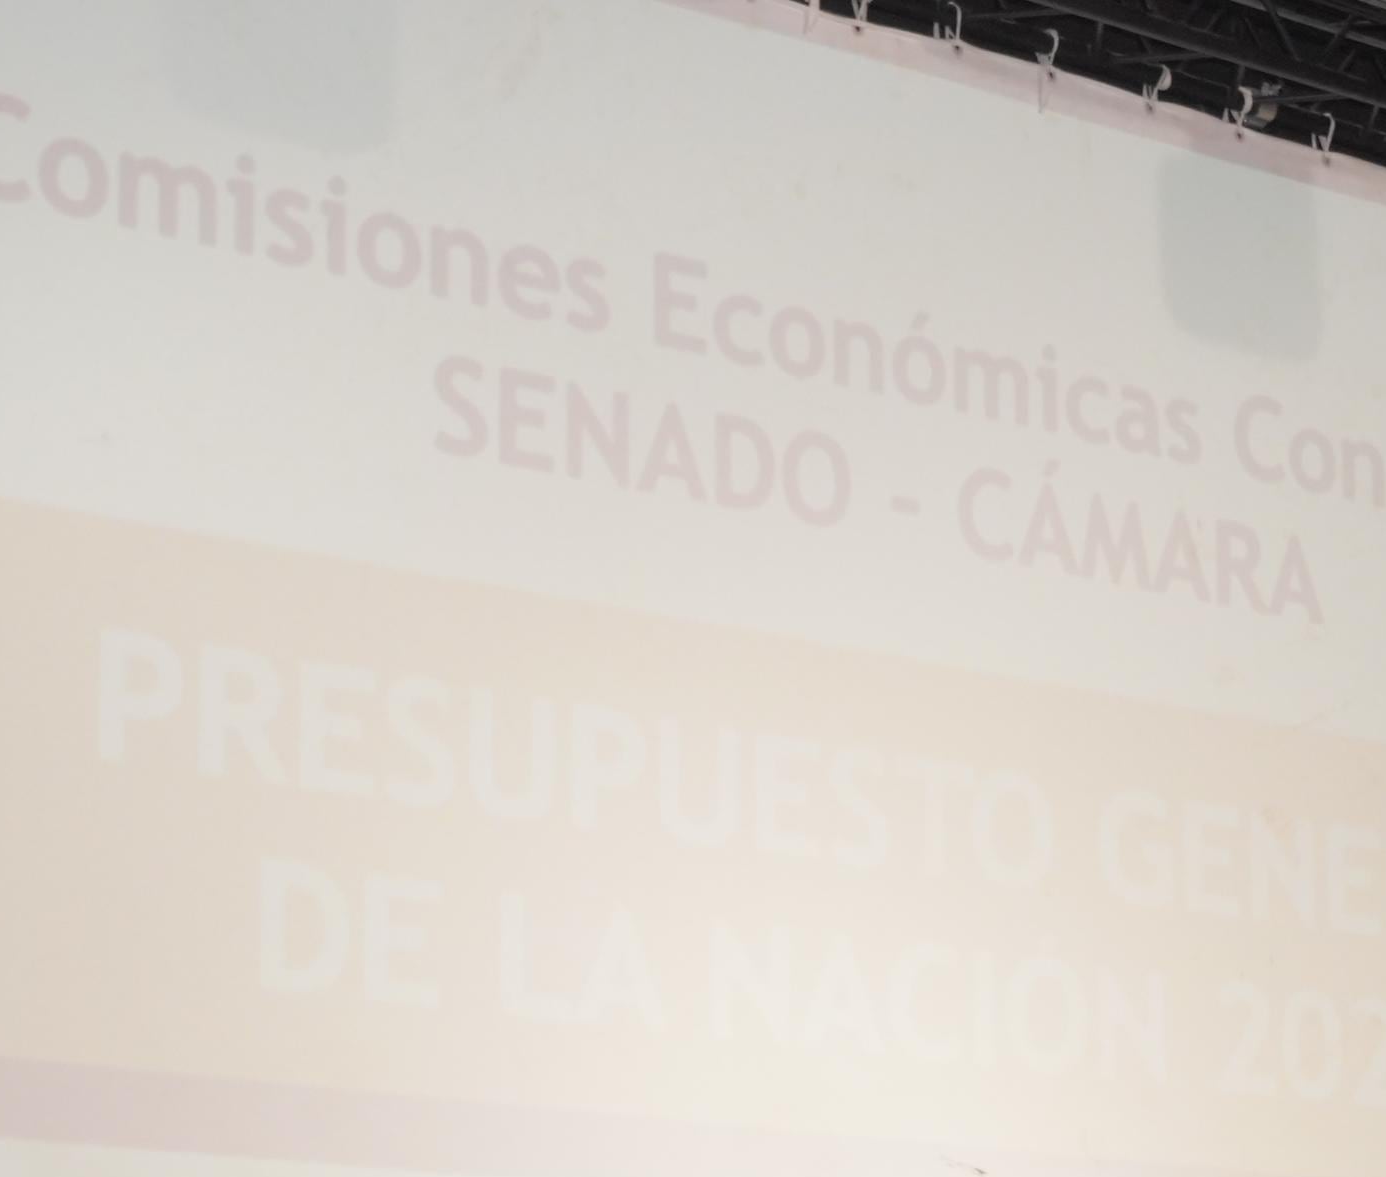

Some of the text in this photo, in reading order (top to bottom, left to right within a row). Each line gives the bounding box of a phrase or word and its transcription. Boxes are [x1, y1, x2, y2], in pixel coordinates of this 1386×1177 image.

[653, 256, 1201, 466] Económicas
[433, 354, 852, 529] SENADO
[957, 457, 1324, 628] CÁMARA
[98, 627, 1053, 890] PRESUPUESTO
[258, 856, 442, 1009] DE
[499, 888, 670, 1036] LA
[711, 922, 1170, 1086] NACIÓN
